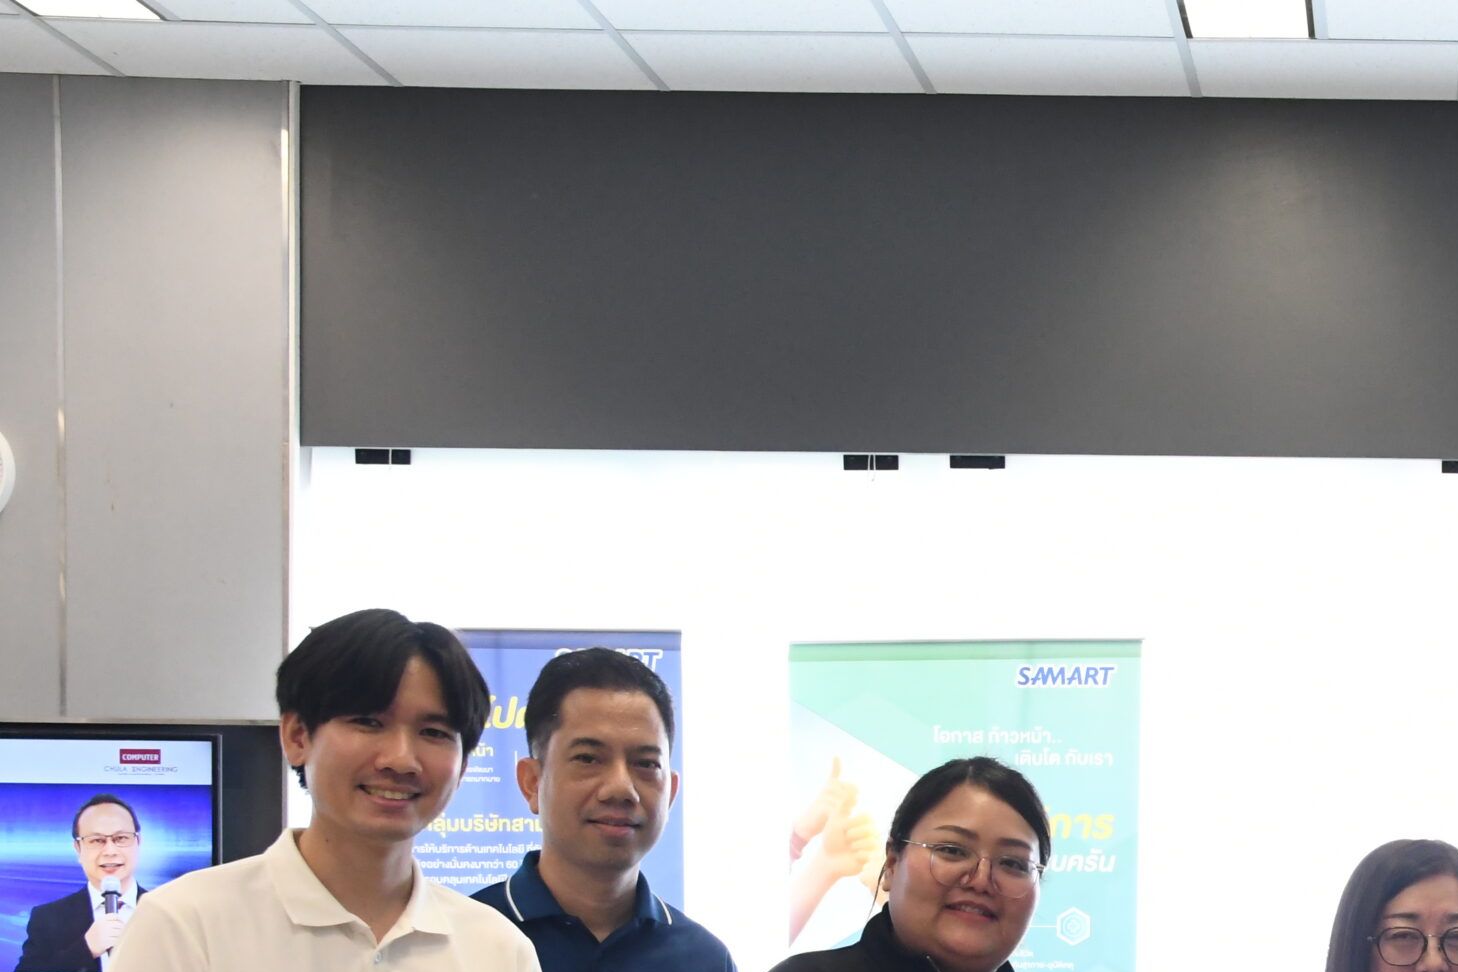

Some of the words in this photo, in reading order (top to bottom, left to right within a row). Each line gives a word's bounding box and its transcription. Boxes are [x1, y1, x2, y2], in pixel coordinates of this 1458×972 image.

[1017, 666, 1115, 686] SAMART
[933, 726, 983, 744] โอกาส
[122, 753, 159, 761] COMPUTER
[1065, 749, 1113, 767] กับเรา
[505, 860, 518, 869] 60
